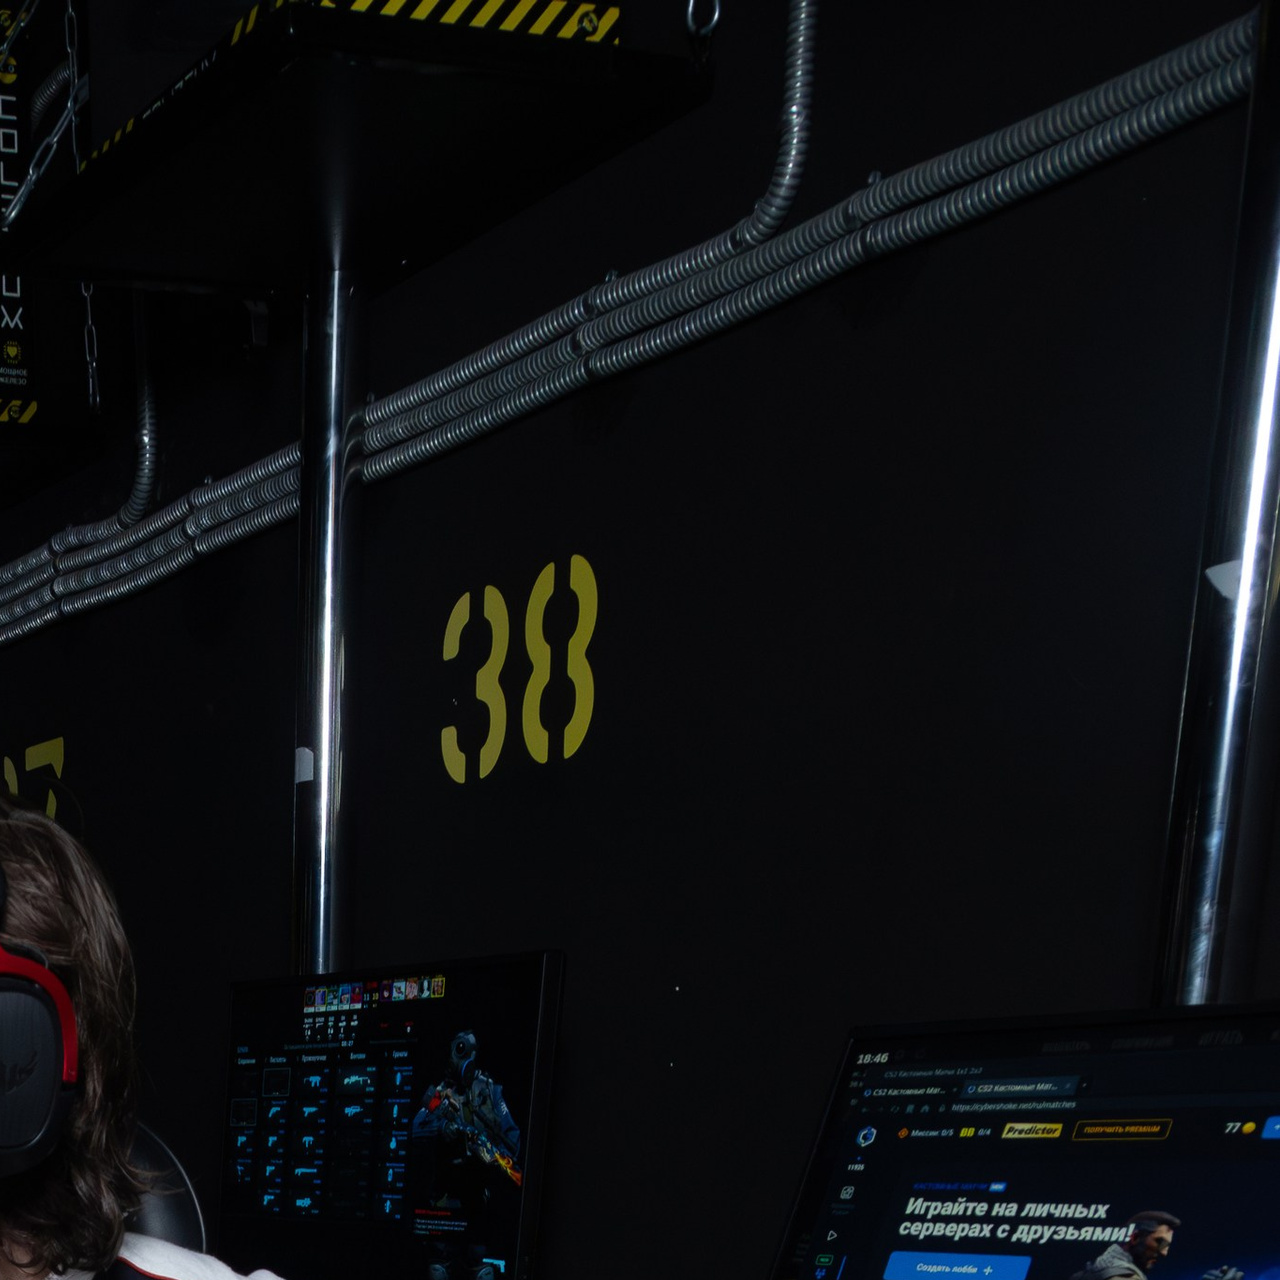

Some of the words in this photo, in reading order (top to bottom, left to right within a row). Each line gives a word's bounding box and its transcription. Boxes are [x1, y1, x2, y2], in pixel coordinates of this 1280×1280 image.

[441, 554, 598, 784] 38
[1006, 1125, 1059, 1136] Predictor
[1224, 1121, 1242, 1134] 77
[905, 1197, 989, 1219] Играйте
[991, 1202, 1019, 1217] на
[1021, 1202, 1110, 1219] личных
[898, 1221, 994, 1241] серверах
[996, 1224, 1010, 1238] с
[1011, 1222, 1137, 1244] друзьями!
[916, 1263, 951, 1274] Создать
[952, 1264, 978, 1274] лобби
